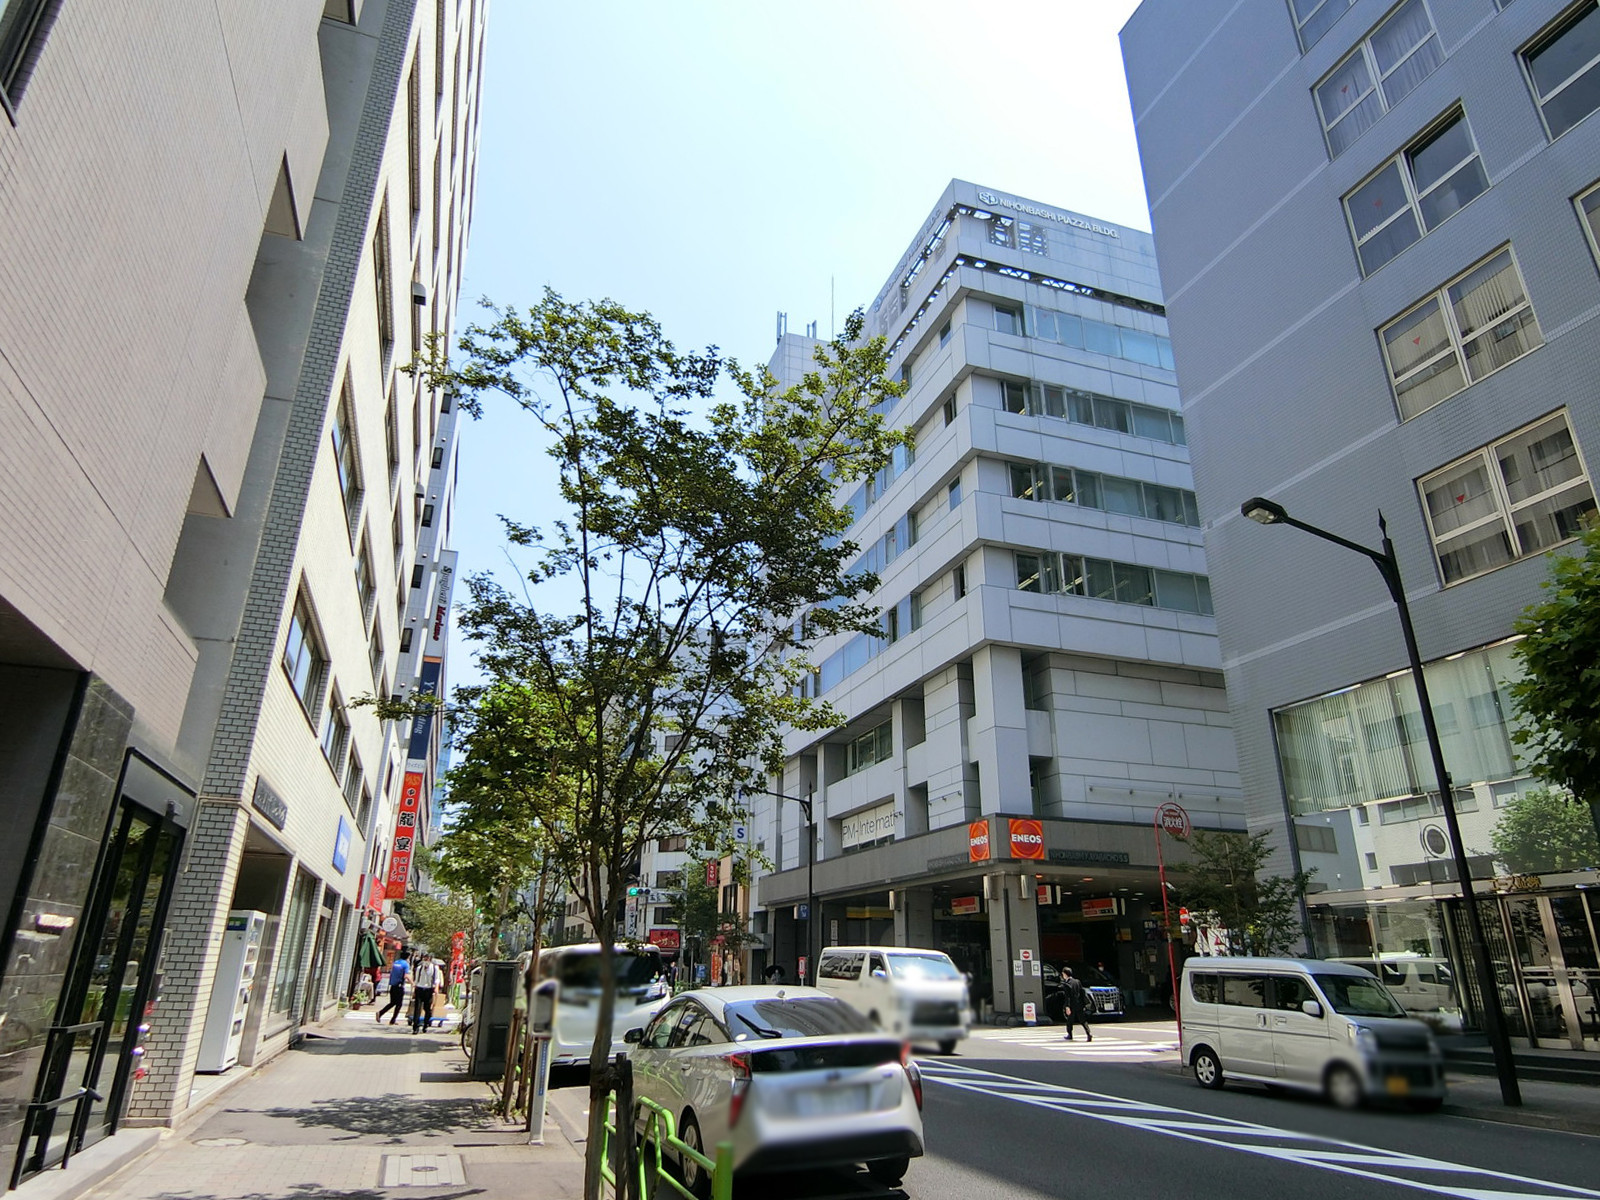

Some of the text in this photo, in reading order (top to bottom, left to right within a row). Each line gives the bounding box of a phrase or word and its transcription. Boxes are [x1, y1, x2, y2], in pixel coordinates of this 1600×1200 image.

[999, 198, 1121, 239] NIHONBASHI PIAZZA BLDG.
[970, 835, 988, 846] ENEOS
[1011, 834, 1042, 844] ENEOS
